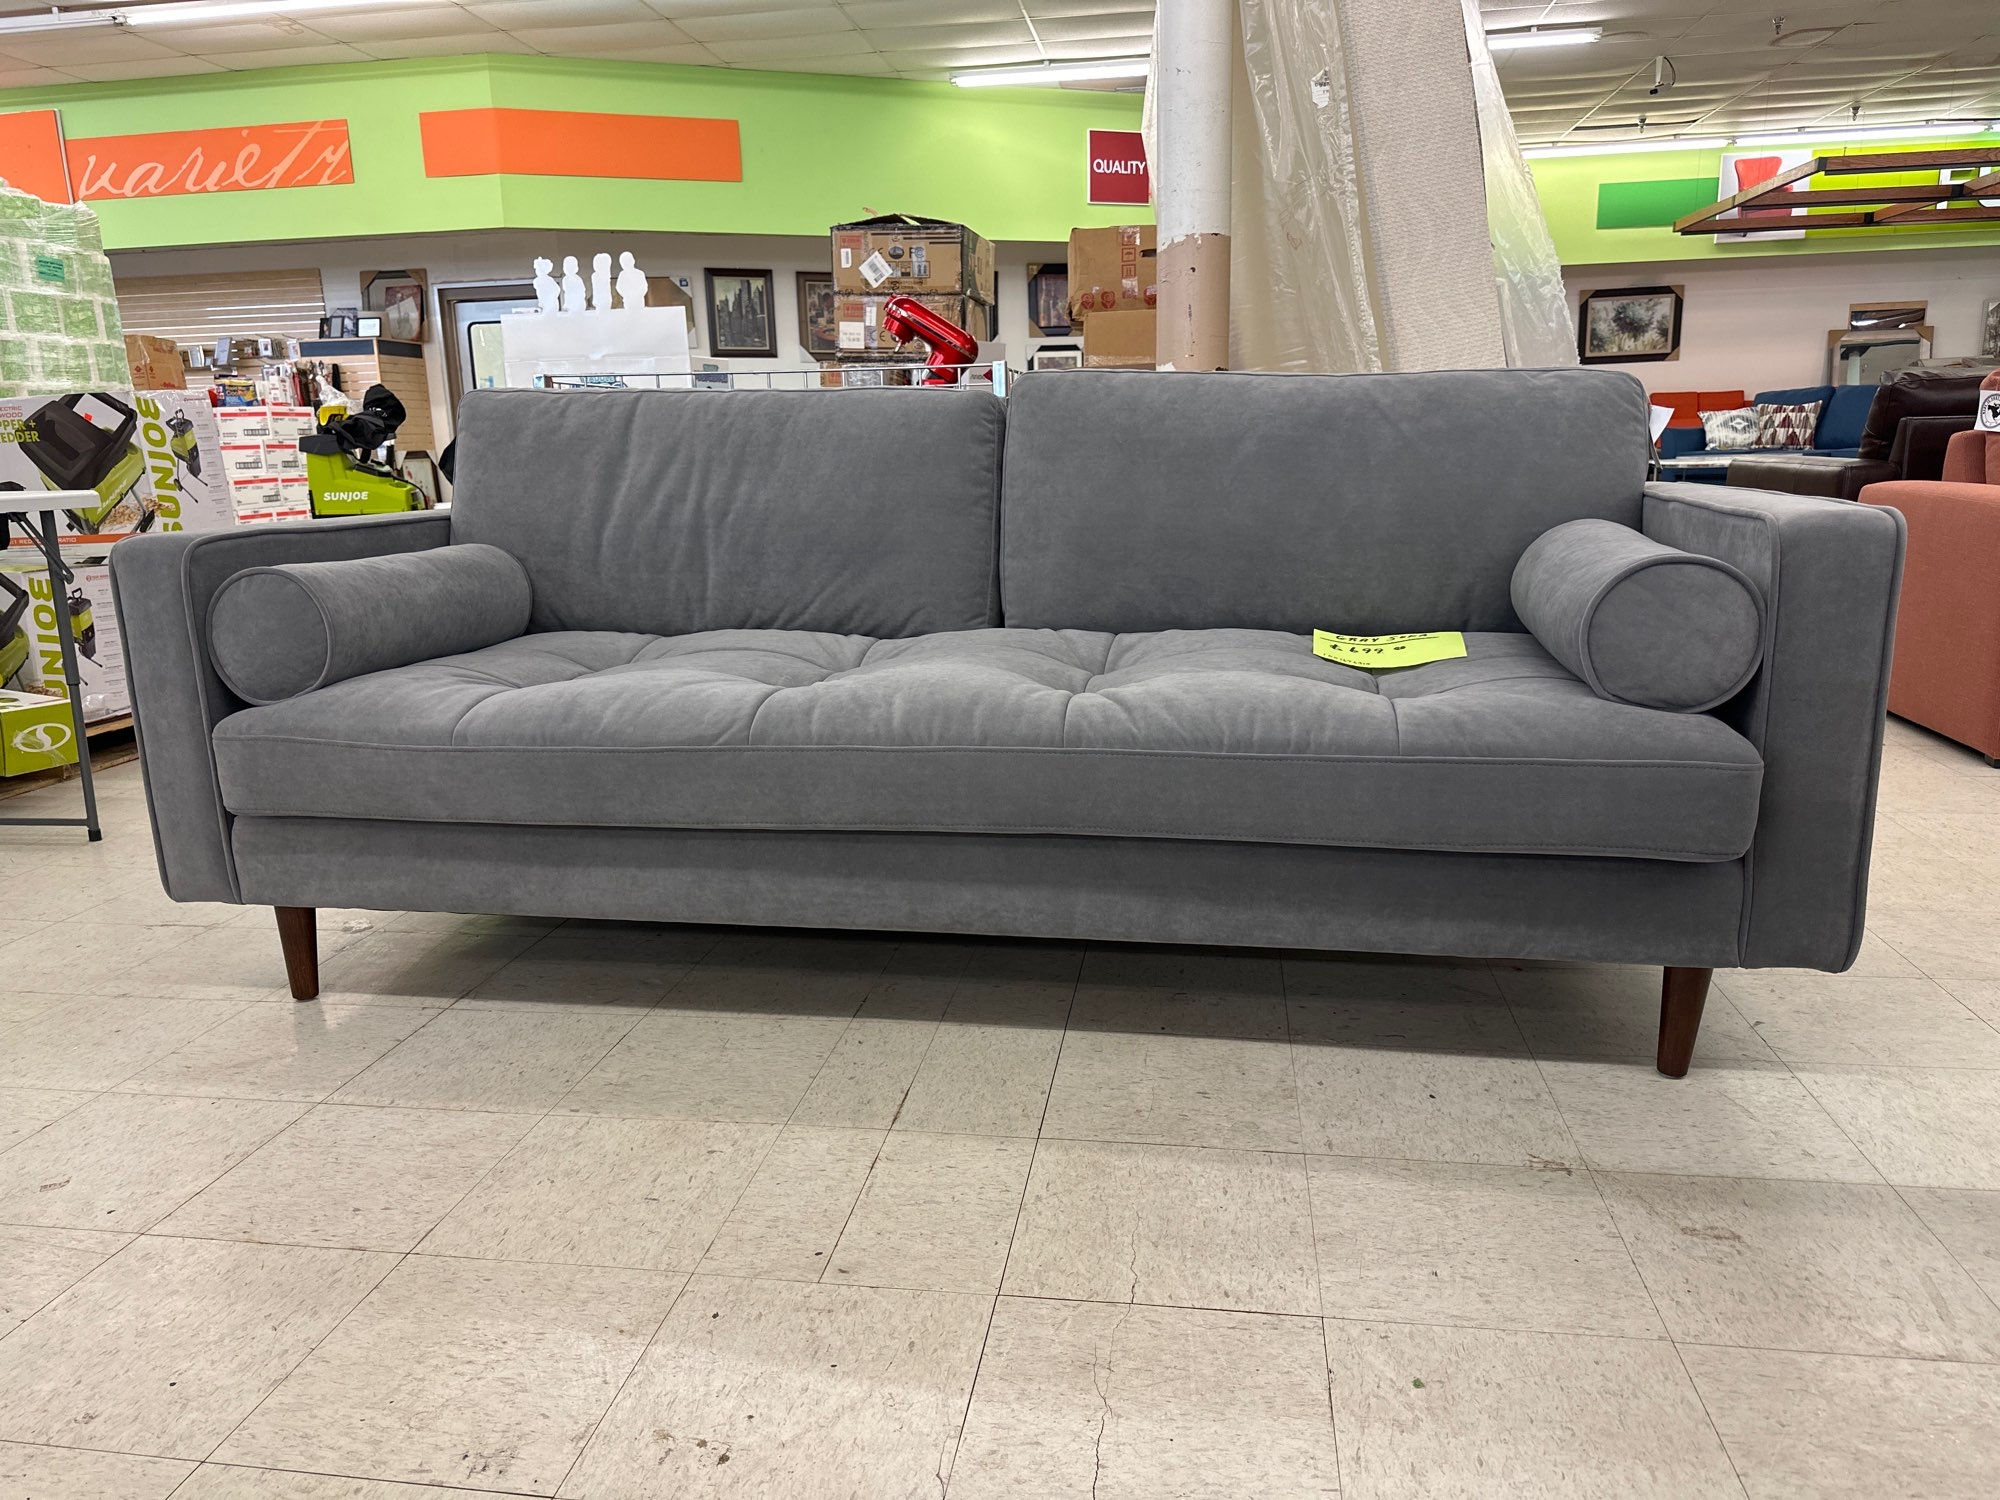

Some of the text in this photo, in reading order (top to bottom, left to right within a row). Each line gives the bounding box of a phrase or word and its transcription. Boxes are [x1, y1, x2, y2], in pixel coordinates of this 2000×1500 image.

[1093, 158, 1146, 175] QUALITY
[0, 431, 41, 443] EDDER
[323, 491, 369, 502] SUNJOE
